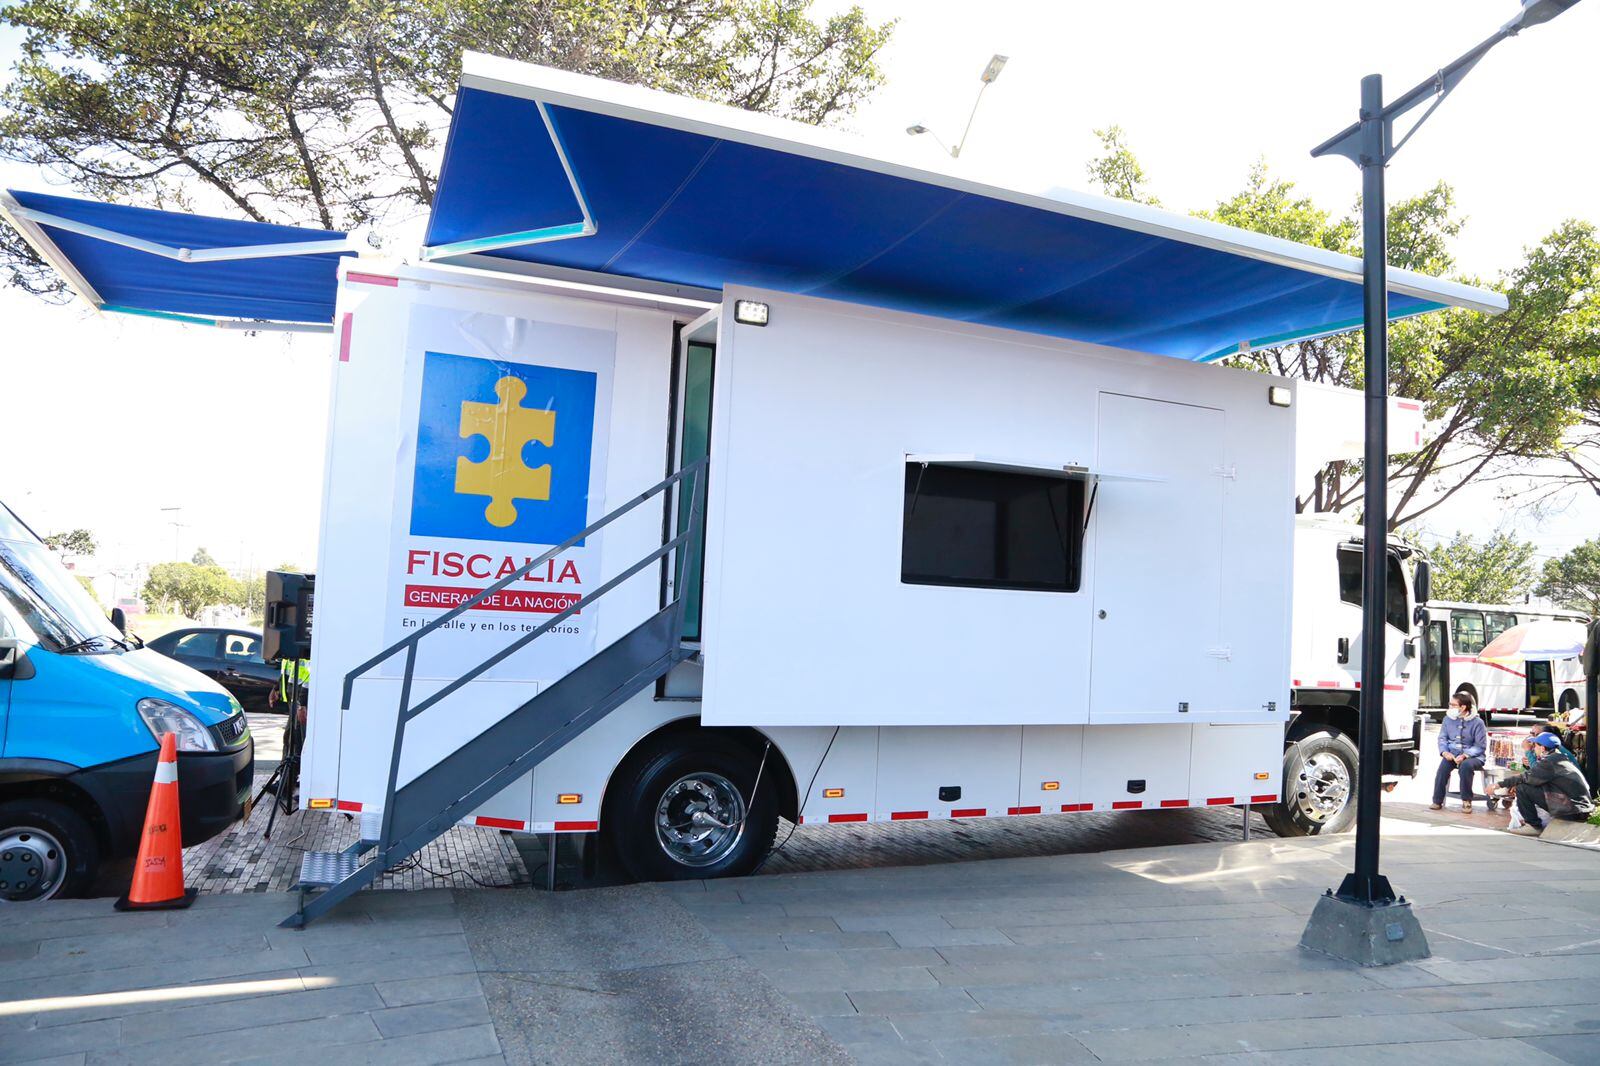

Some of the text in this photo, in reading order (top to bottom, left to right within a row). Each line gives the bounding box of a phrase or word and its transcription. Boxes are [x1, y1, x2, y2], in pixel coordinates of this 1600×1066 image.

[406, 549, 582, 584] FISCALIA
[481, 594, 501, 606] DE
[504, 595, 522, 607] LA
[402, 618, 417, 628] En
[438, 619, 466, 630] alle
[470, 623, 477, 632] y
[480, 622, 494, 631] en
[499, 622, 516, 632] los
